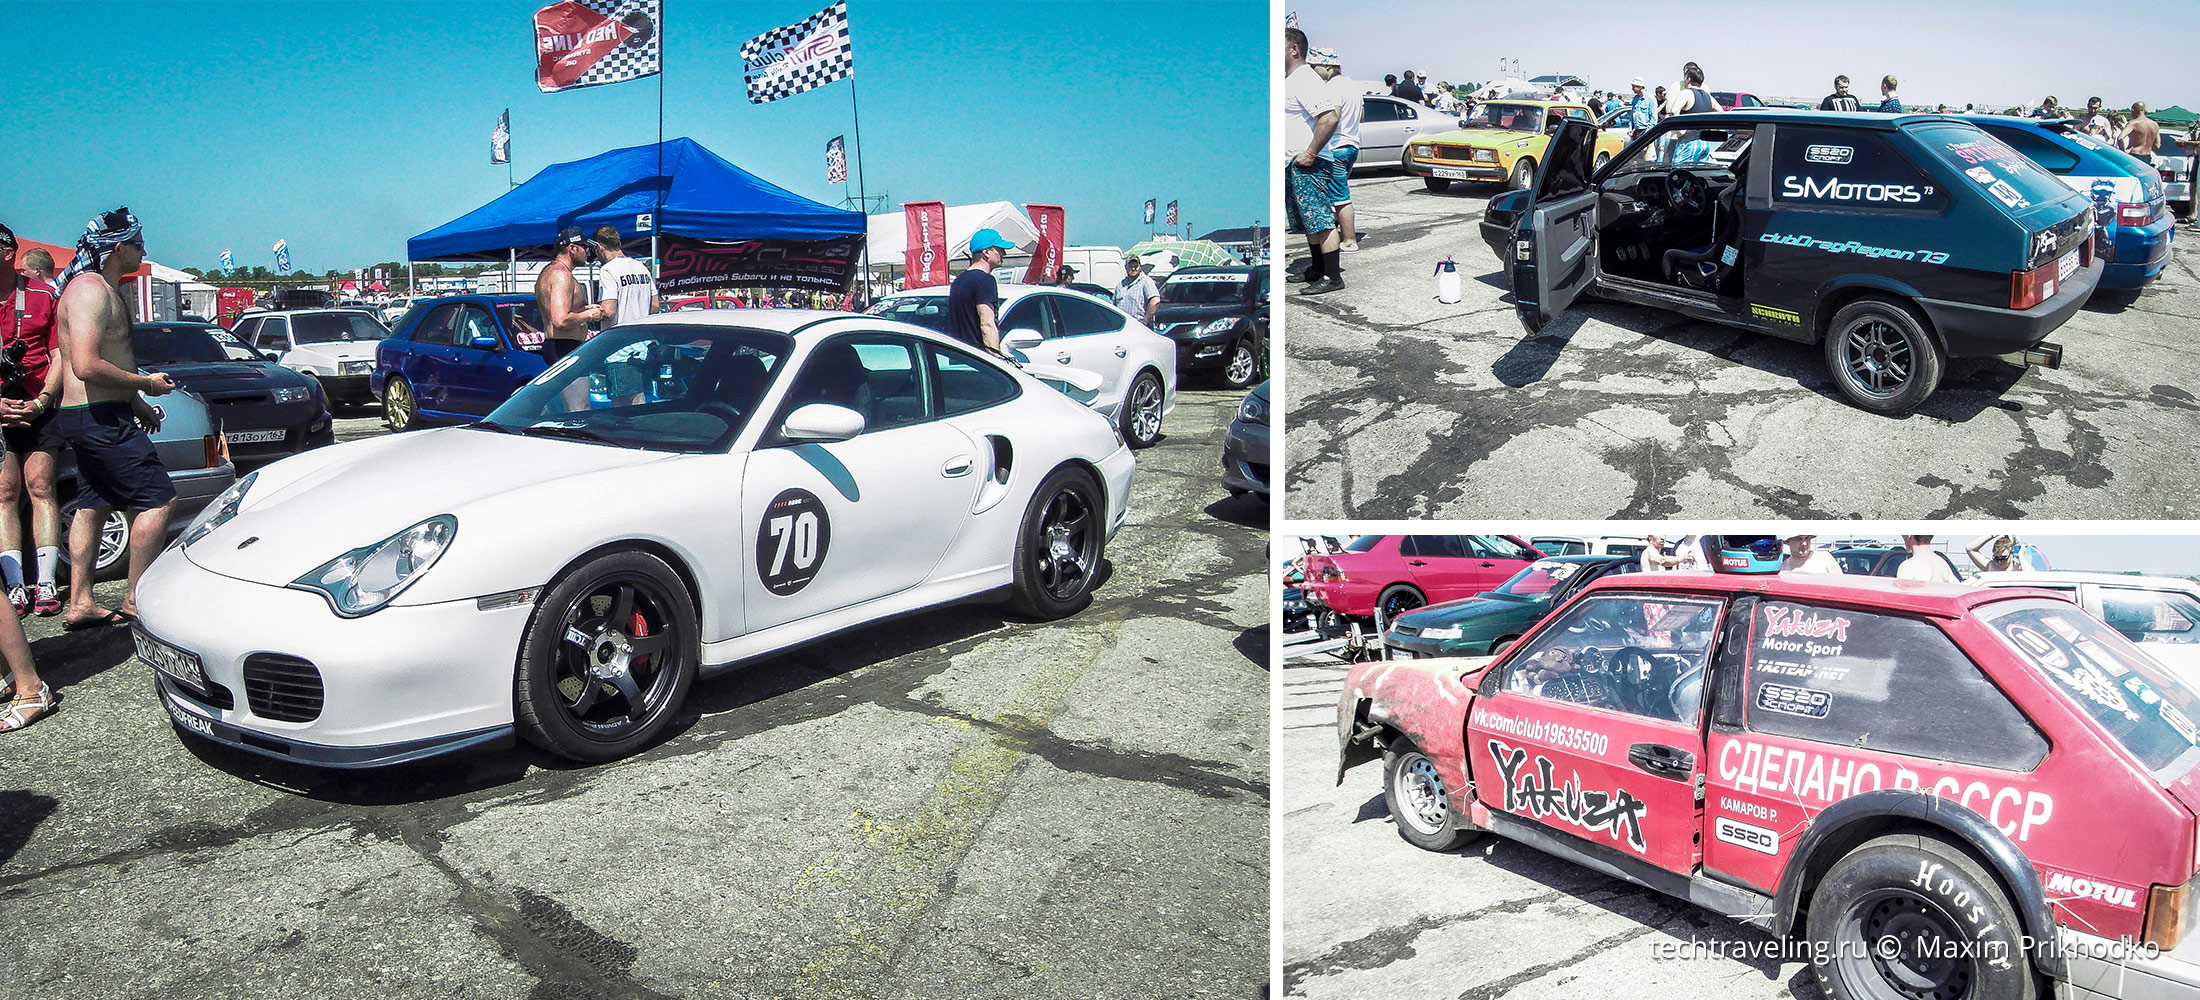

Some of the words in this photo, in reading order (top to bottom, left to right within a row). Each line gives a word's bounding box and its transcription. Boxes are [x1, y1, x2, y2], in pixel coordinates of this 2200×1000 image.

[1923, 186, 1934, 195] 73
[678, 273, 728, 285] любителей
[769, 511, 818, 577] 70
[1723, 558, 1748, 567] MOTUL
[1762, 637, 1803, 653] Motor
[1804, 641, 1843, 656] Sport
[1766, 686, 1826, 706] SS20
[1474, 708, 1609, 756] vk.com/club19635500
[1719, 739, 1882, 802] СДЕЛАНО
[1720, 796, 1769, 821] КАМАРОВ
[1722, 824, 1771, 848] SS20
[2050, 872, 2138, 908] MOTUL
